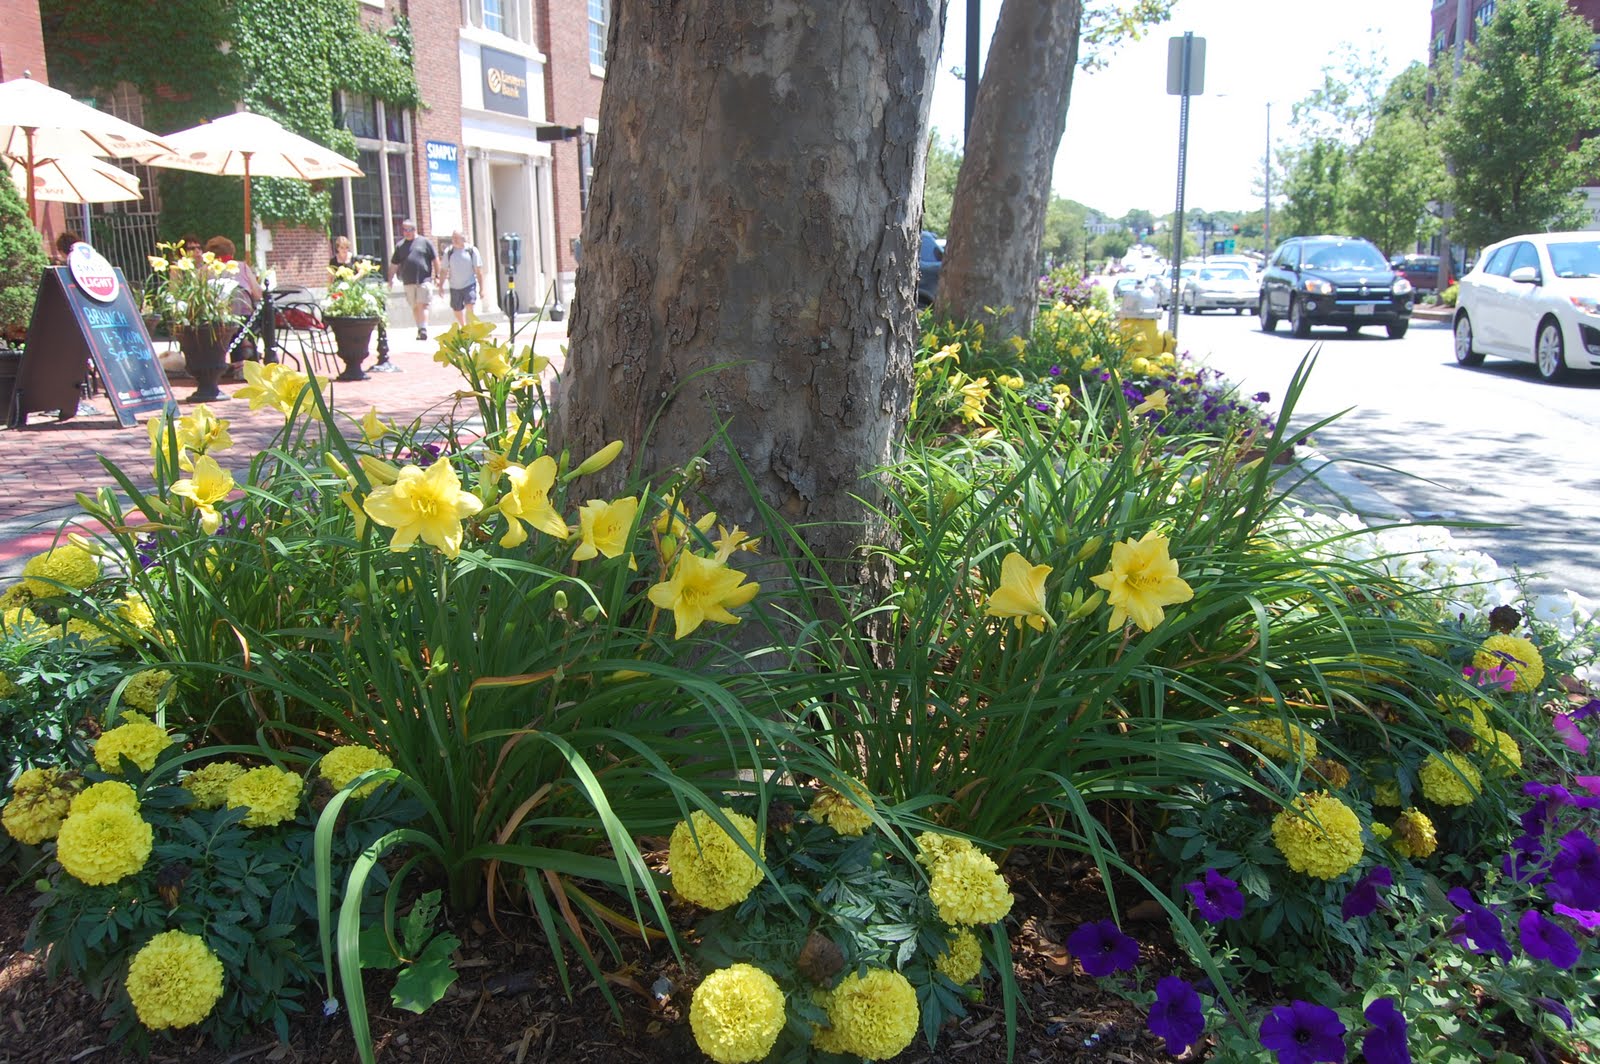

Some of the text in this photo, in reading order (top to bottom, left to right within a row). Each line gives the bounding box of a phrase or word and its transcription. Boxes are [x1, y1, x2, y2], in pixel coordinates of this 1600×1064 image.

[427, 143, 457, 161] SIMPLY
[84, 277, 113, 288] LIGHT
[83, 307, 127, 325] BRUNCH
